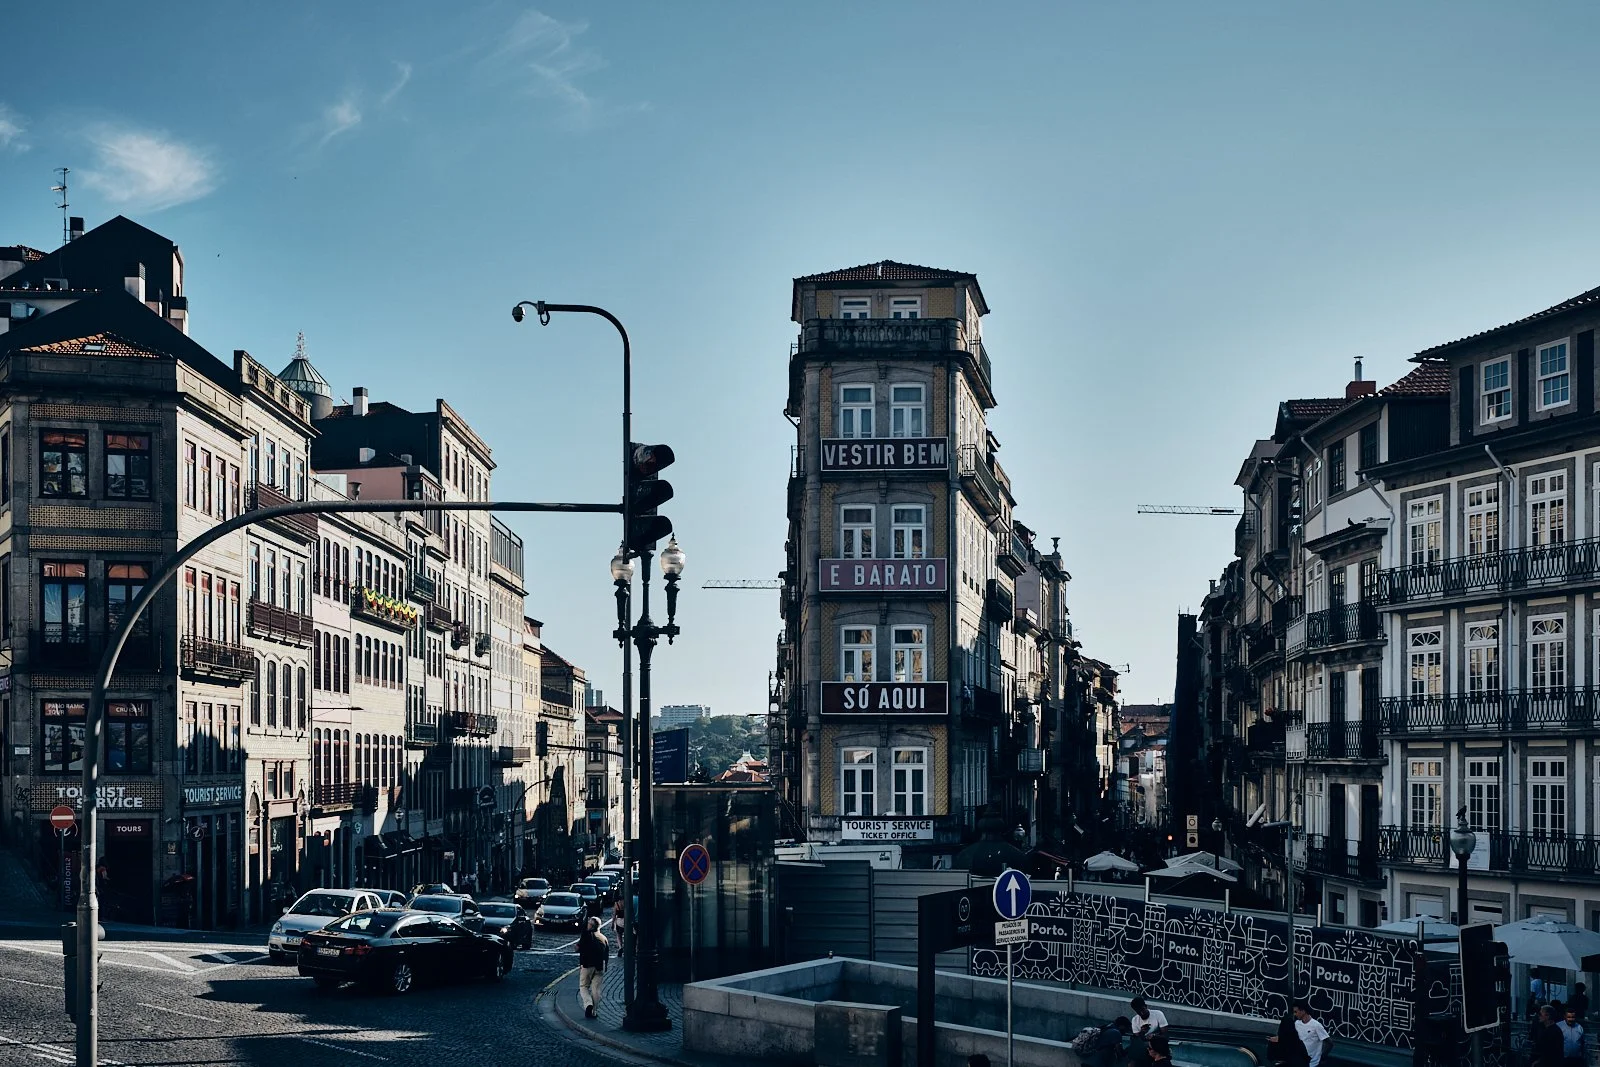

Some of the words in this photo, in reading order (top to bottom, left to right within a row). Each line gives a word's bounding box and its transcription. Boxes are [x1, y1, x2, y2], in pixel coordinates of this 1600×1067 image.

[824, 444, 895, 466] VESTIR
[904, 443, 945, 465] BEM
[831, 565, 840, 585] E
[855, 564, 936, 585] BARATO
[843, 684, 870, 709] SÓ
[878, 687, 925, 710] AQUI
[56, 787, 126, 798] TORIST
[184, 787, 215, 803] TOURIST
[215, 785, 242, 801] SERVICE
[76, 797, 143, 808] SRVICE
[846, 821, 889, 830] TOURIST
[892, 820, 931, 830] SERVICE
[860, 831, 889, 839] TICKET
[890, 831, 917, 839] OFFICE
[1030, 922, 1068, 936] Porto.
[1168, 941, 1199, 957] Porto.
[1316, 966, 1354, 985] Porto.
